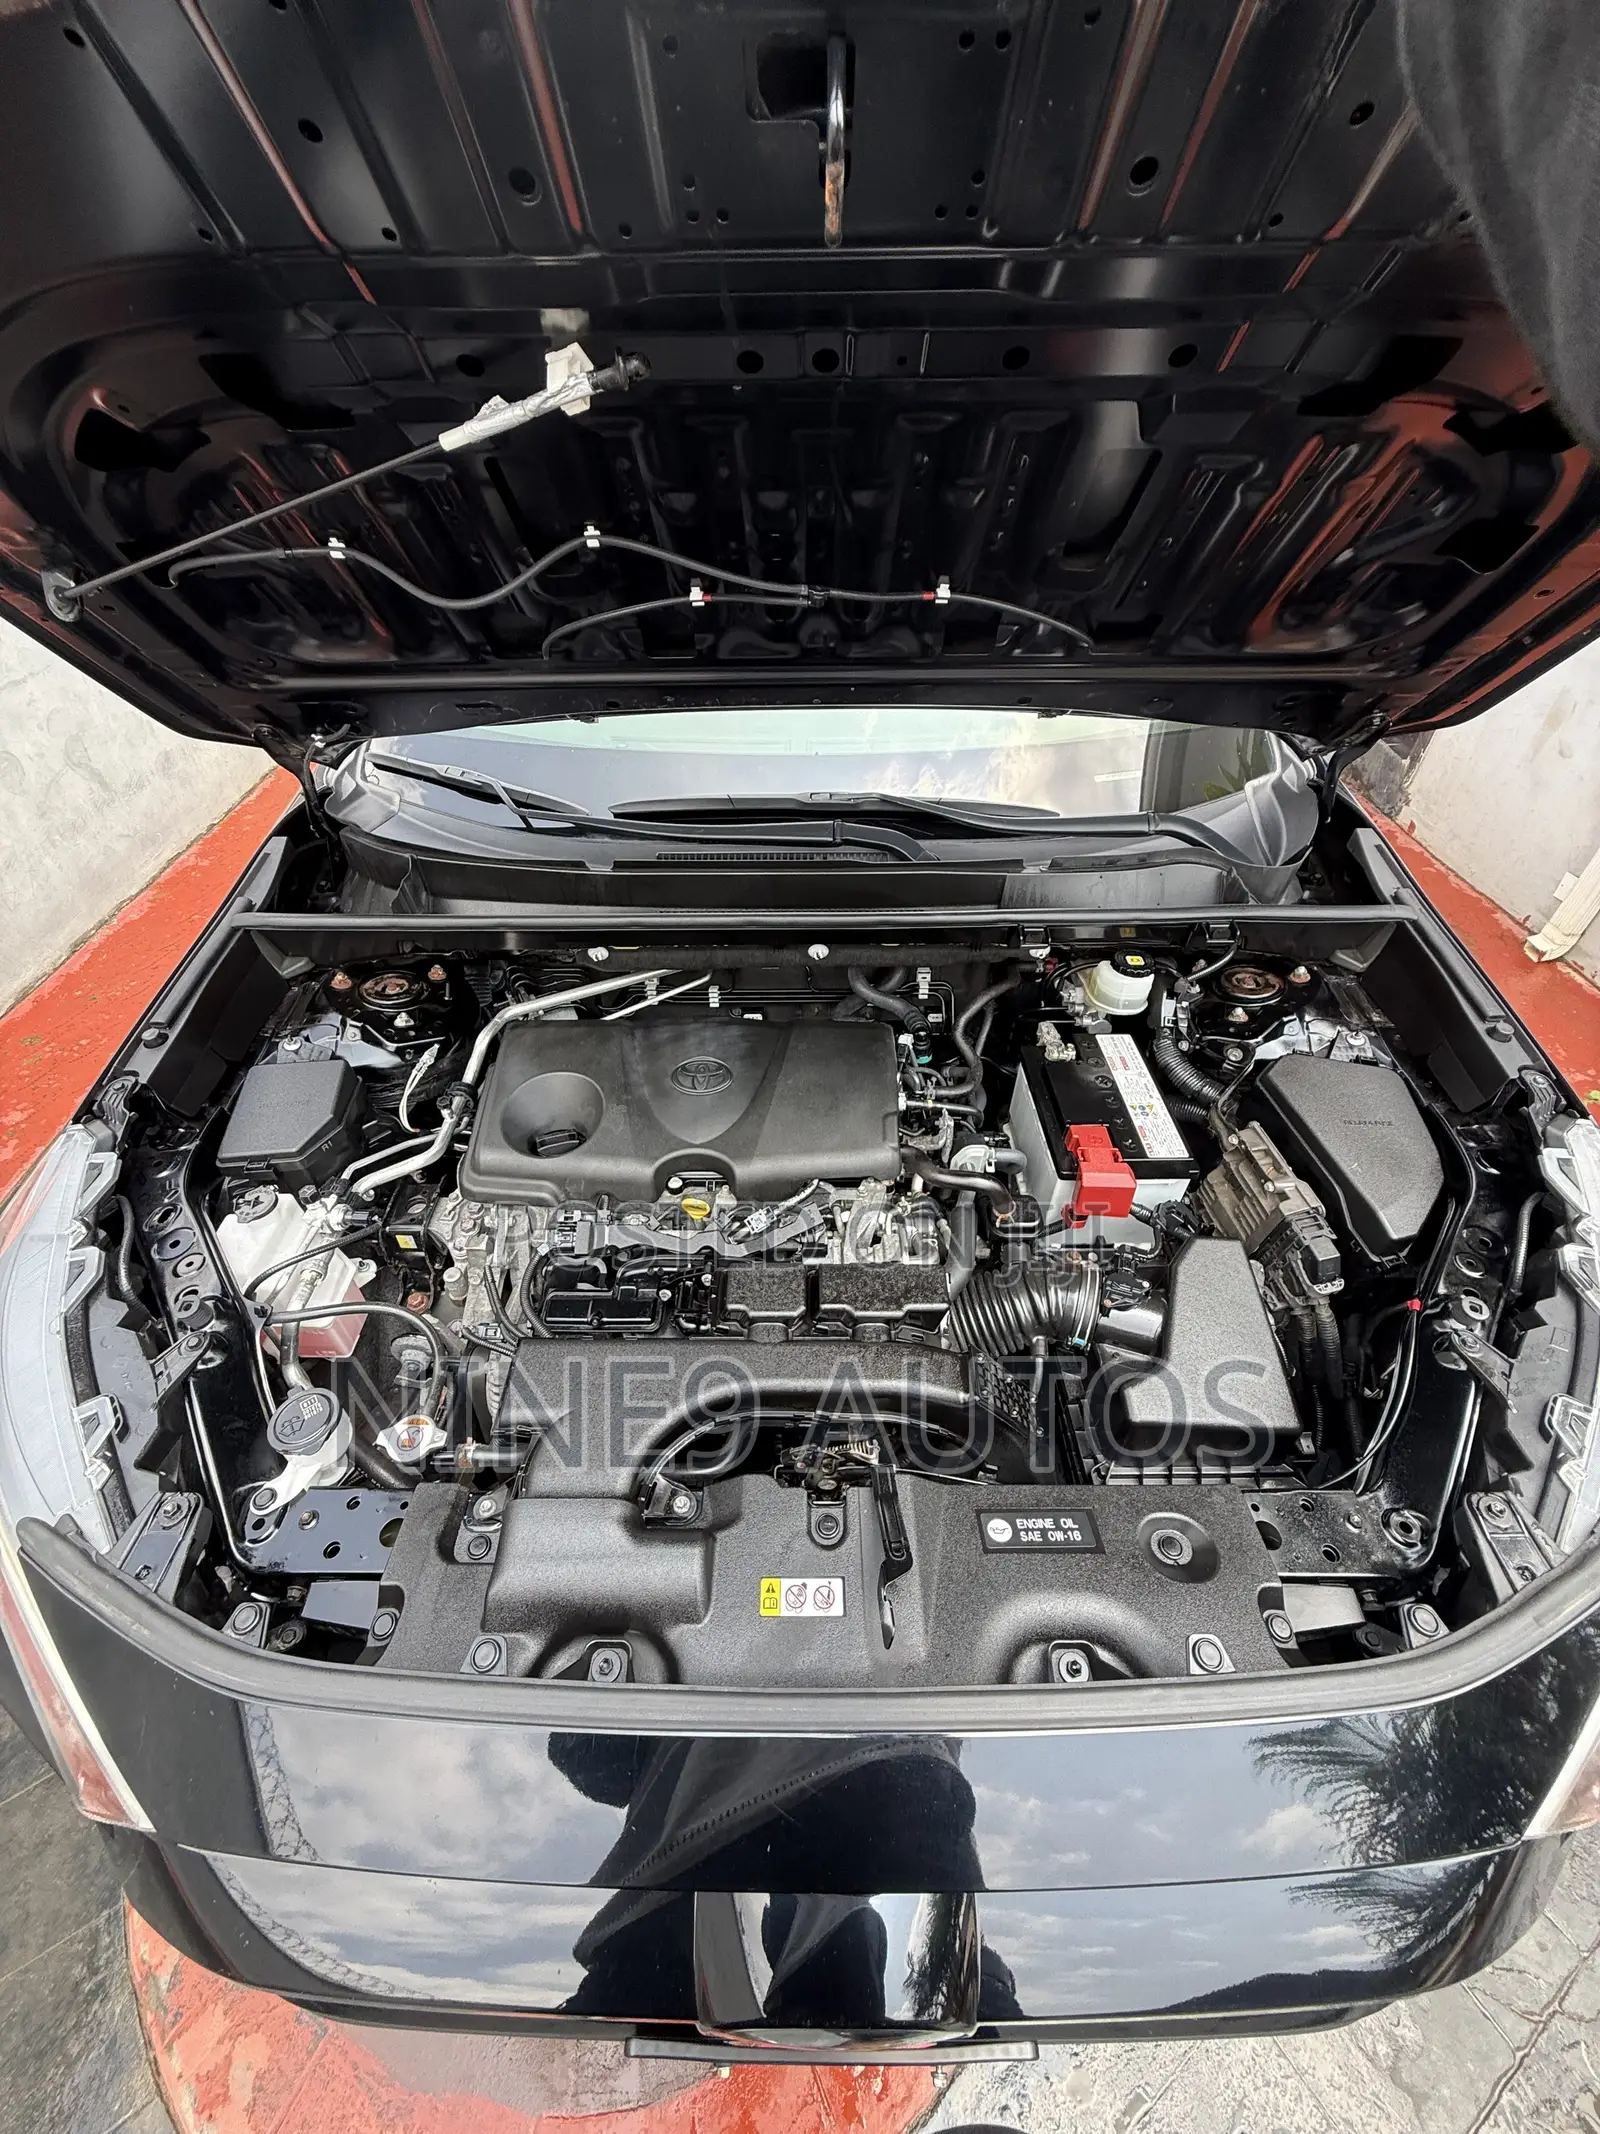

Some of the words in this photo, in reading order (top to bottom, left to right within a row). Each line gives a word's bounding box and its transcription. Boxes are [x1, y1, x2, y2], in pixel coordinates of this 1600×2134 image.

[321, 1141, 333, 1152] R1
[1016, 1518, 1055, 1529] ENGINE
[1060, 1518, 1078, 1529] OIL
[1020, 1530, 1042, 1542] SAE
